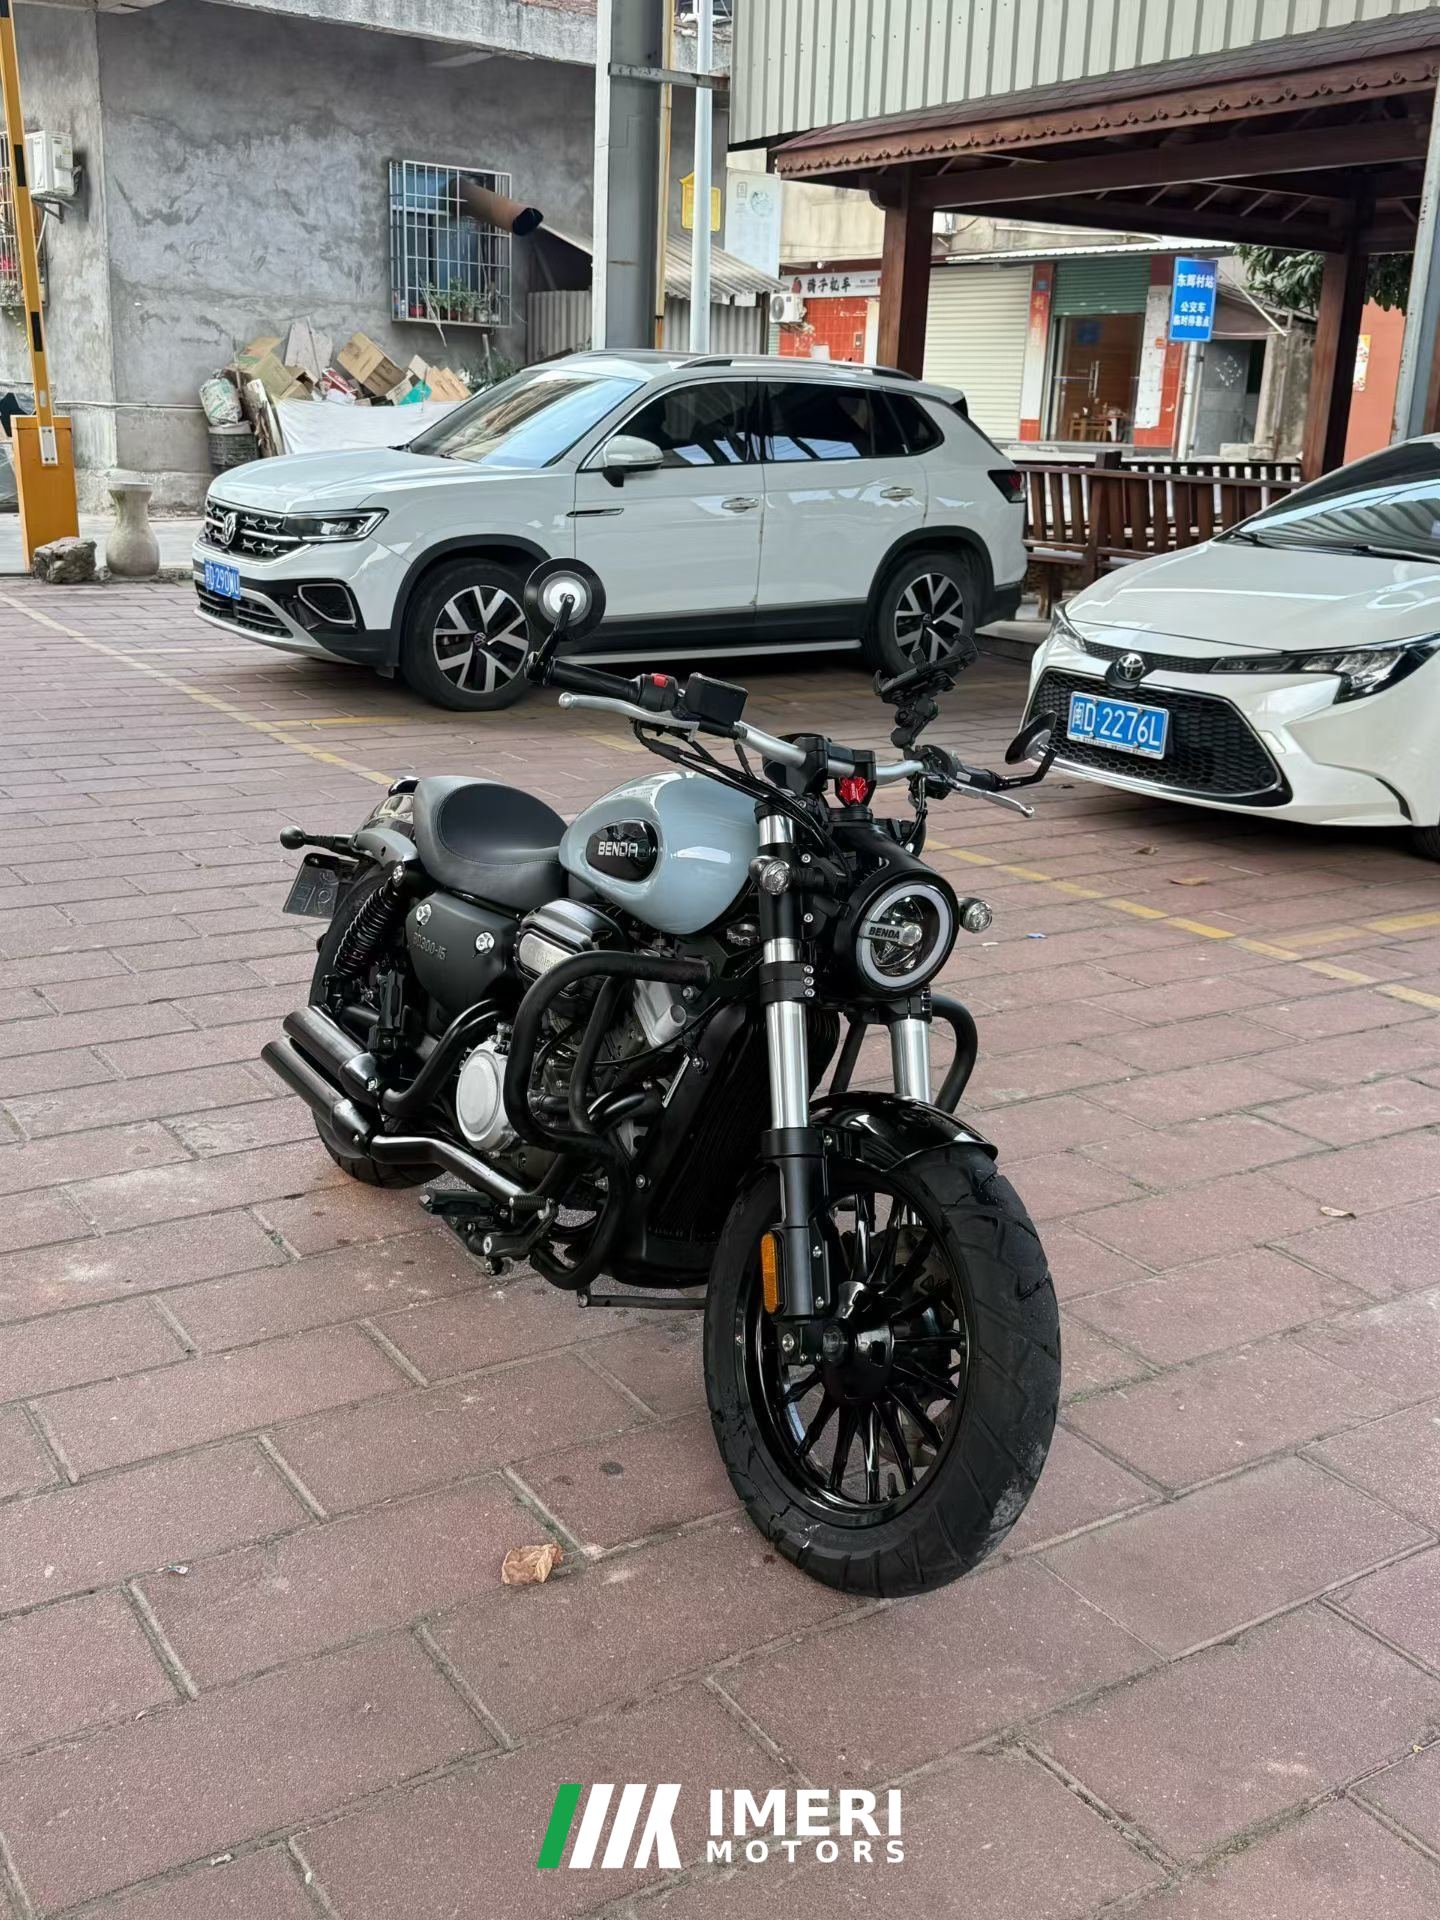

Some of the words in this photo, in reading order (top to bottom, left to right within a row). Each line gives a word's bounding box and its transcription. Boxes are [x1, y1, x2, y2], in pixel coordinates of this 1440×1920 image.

[1180, 301, 1206, 313] 公交车
[598, 841, 638, 857] BENDA
[869, 926, 900, 940] BENDA
